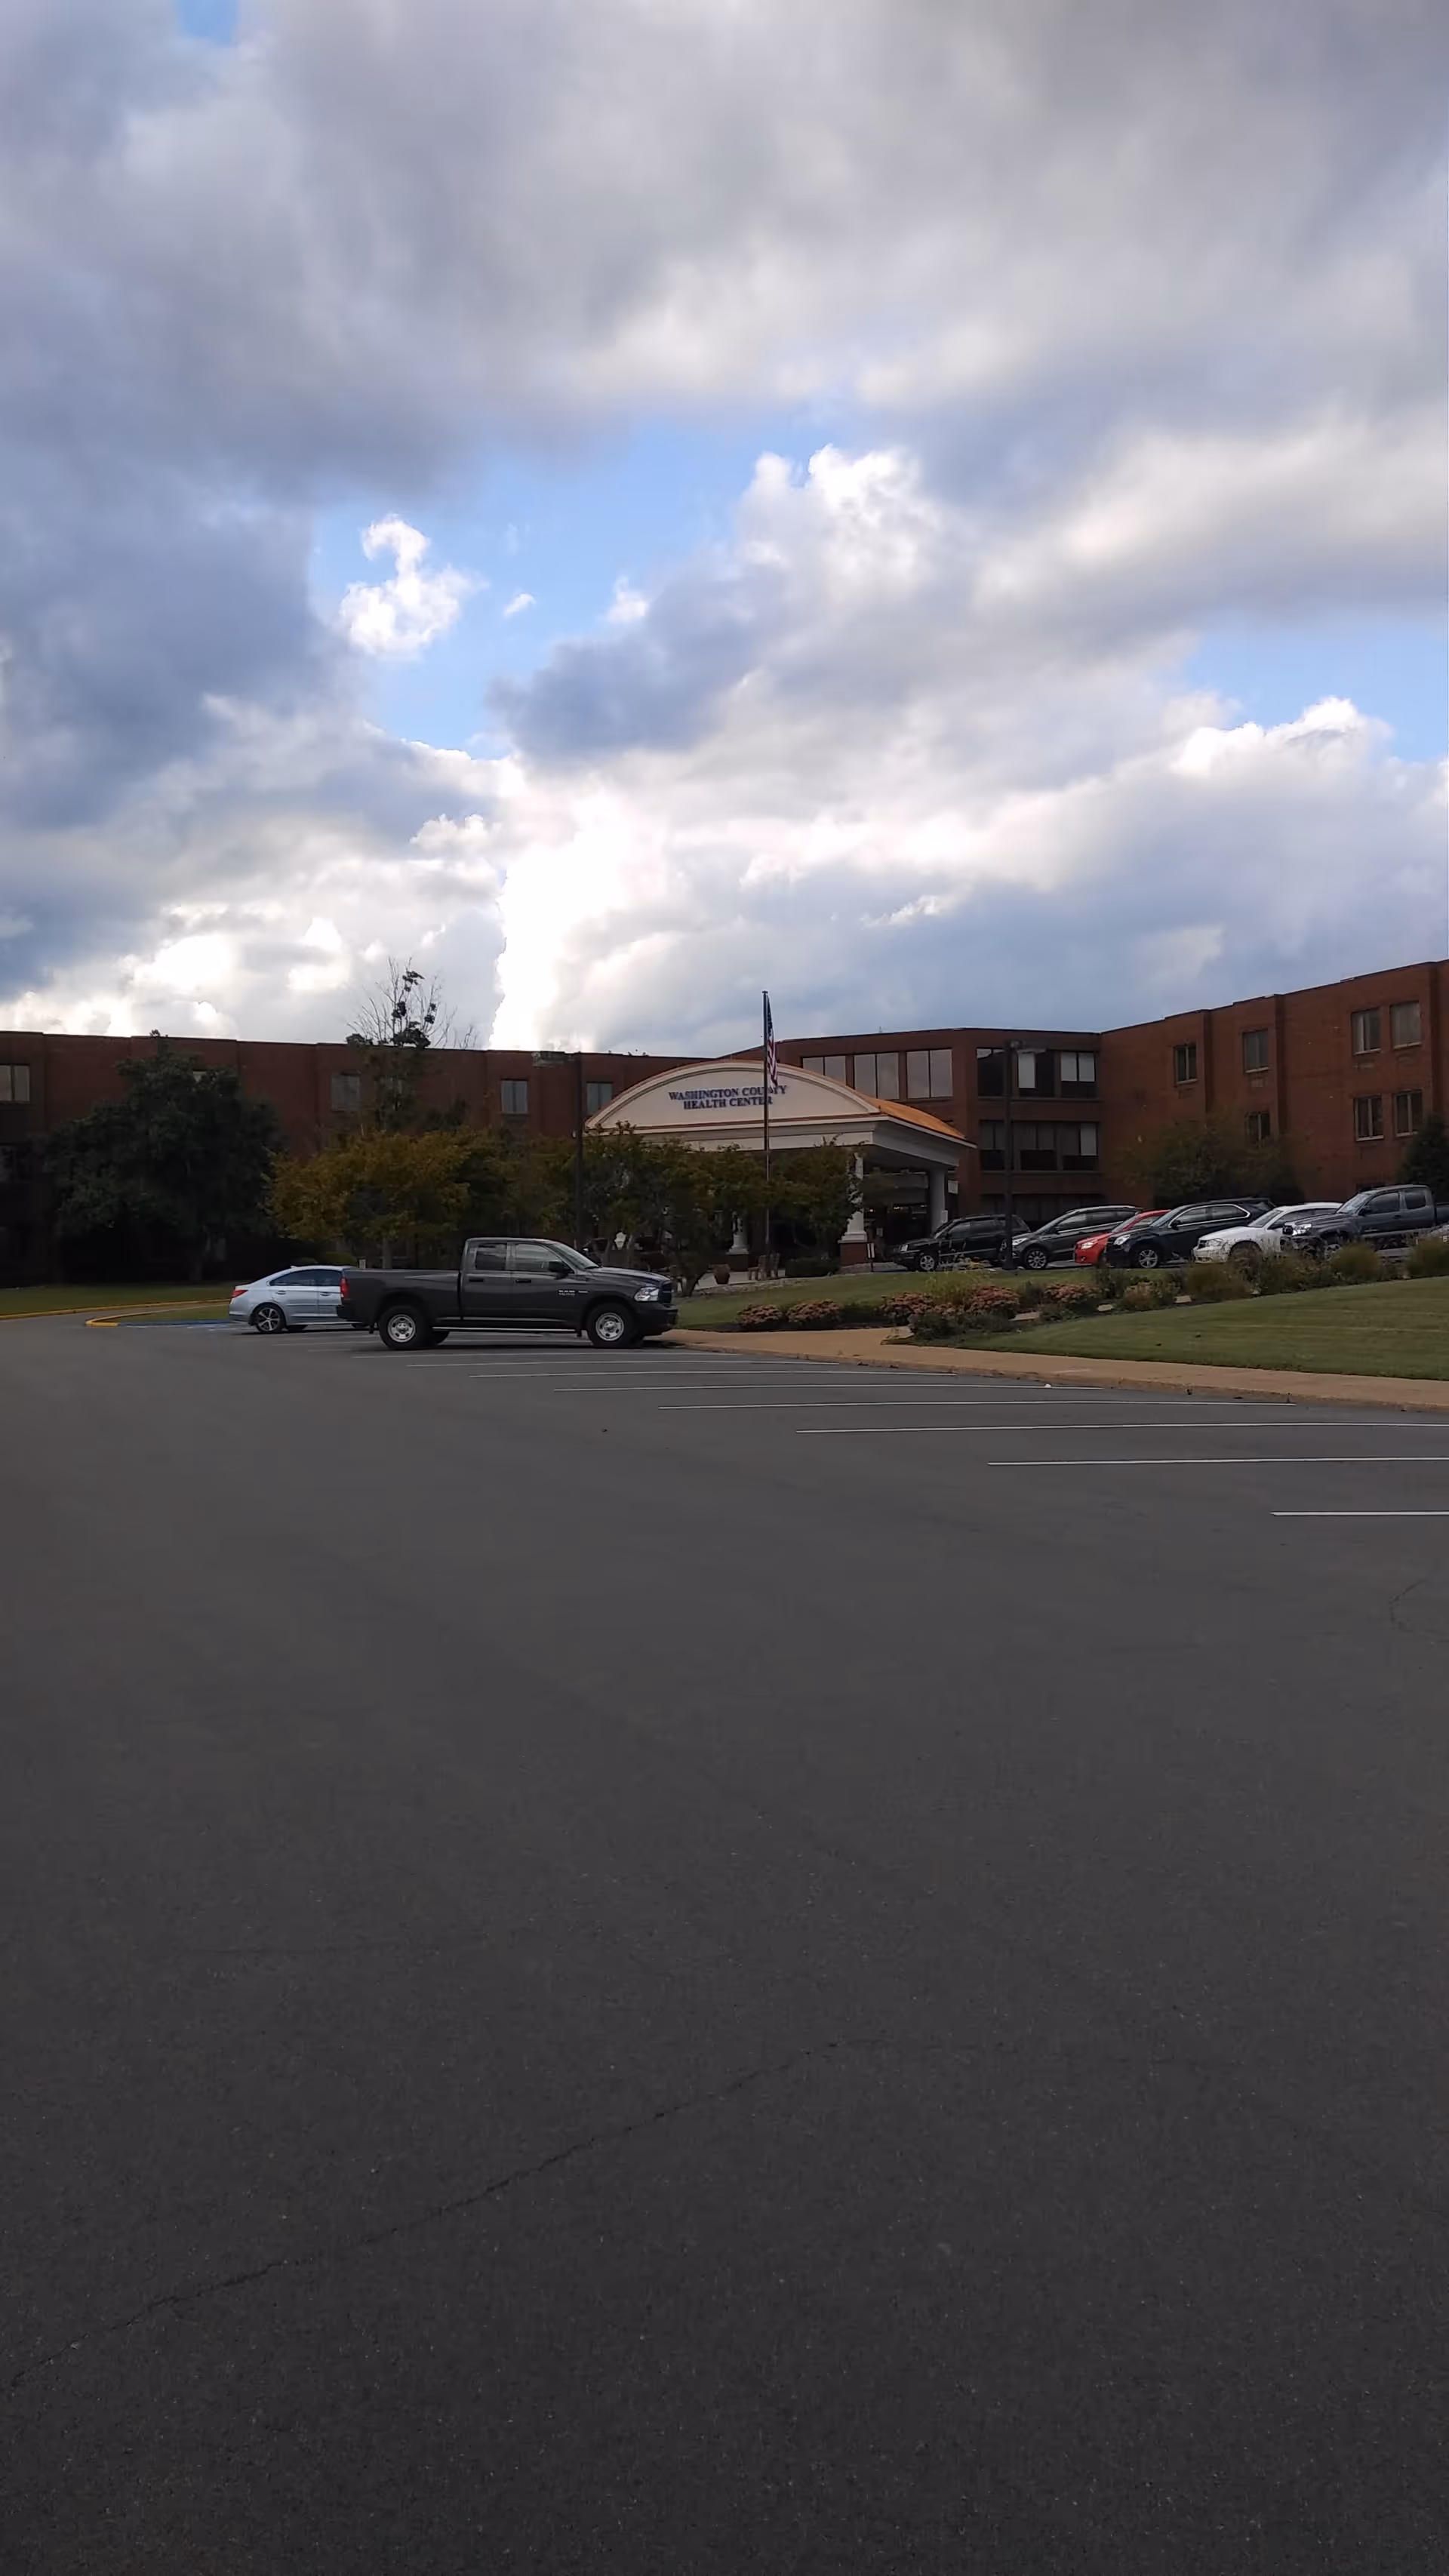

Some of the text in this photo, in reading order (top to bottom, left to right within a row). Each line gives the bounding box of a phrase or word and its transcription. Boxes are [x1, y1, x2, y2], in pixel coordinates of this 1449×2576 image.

[669, 1088, 738, 1100] WASHINGTON
[684, 1096, 773, 1109] HEALTH CENTER
